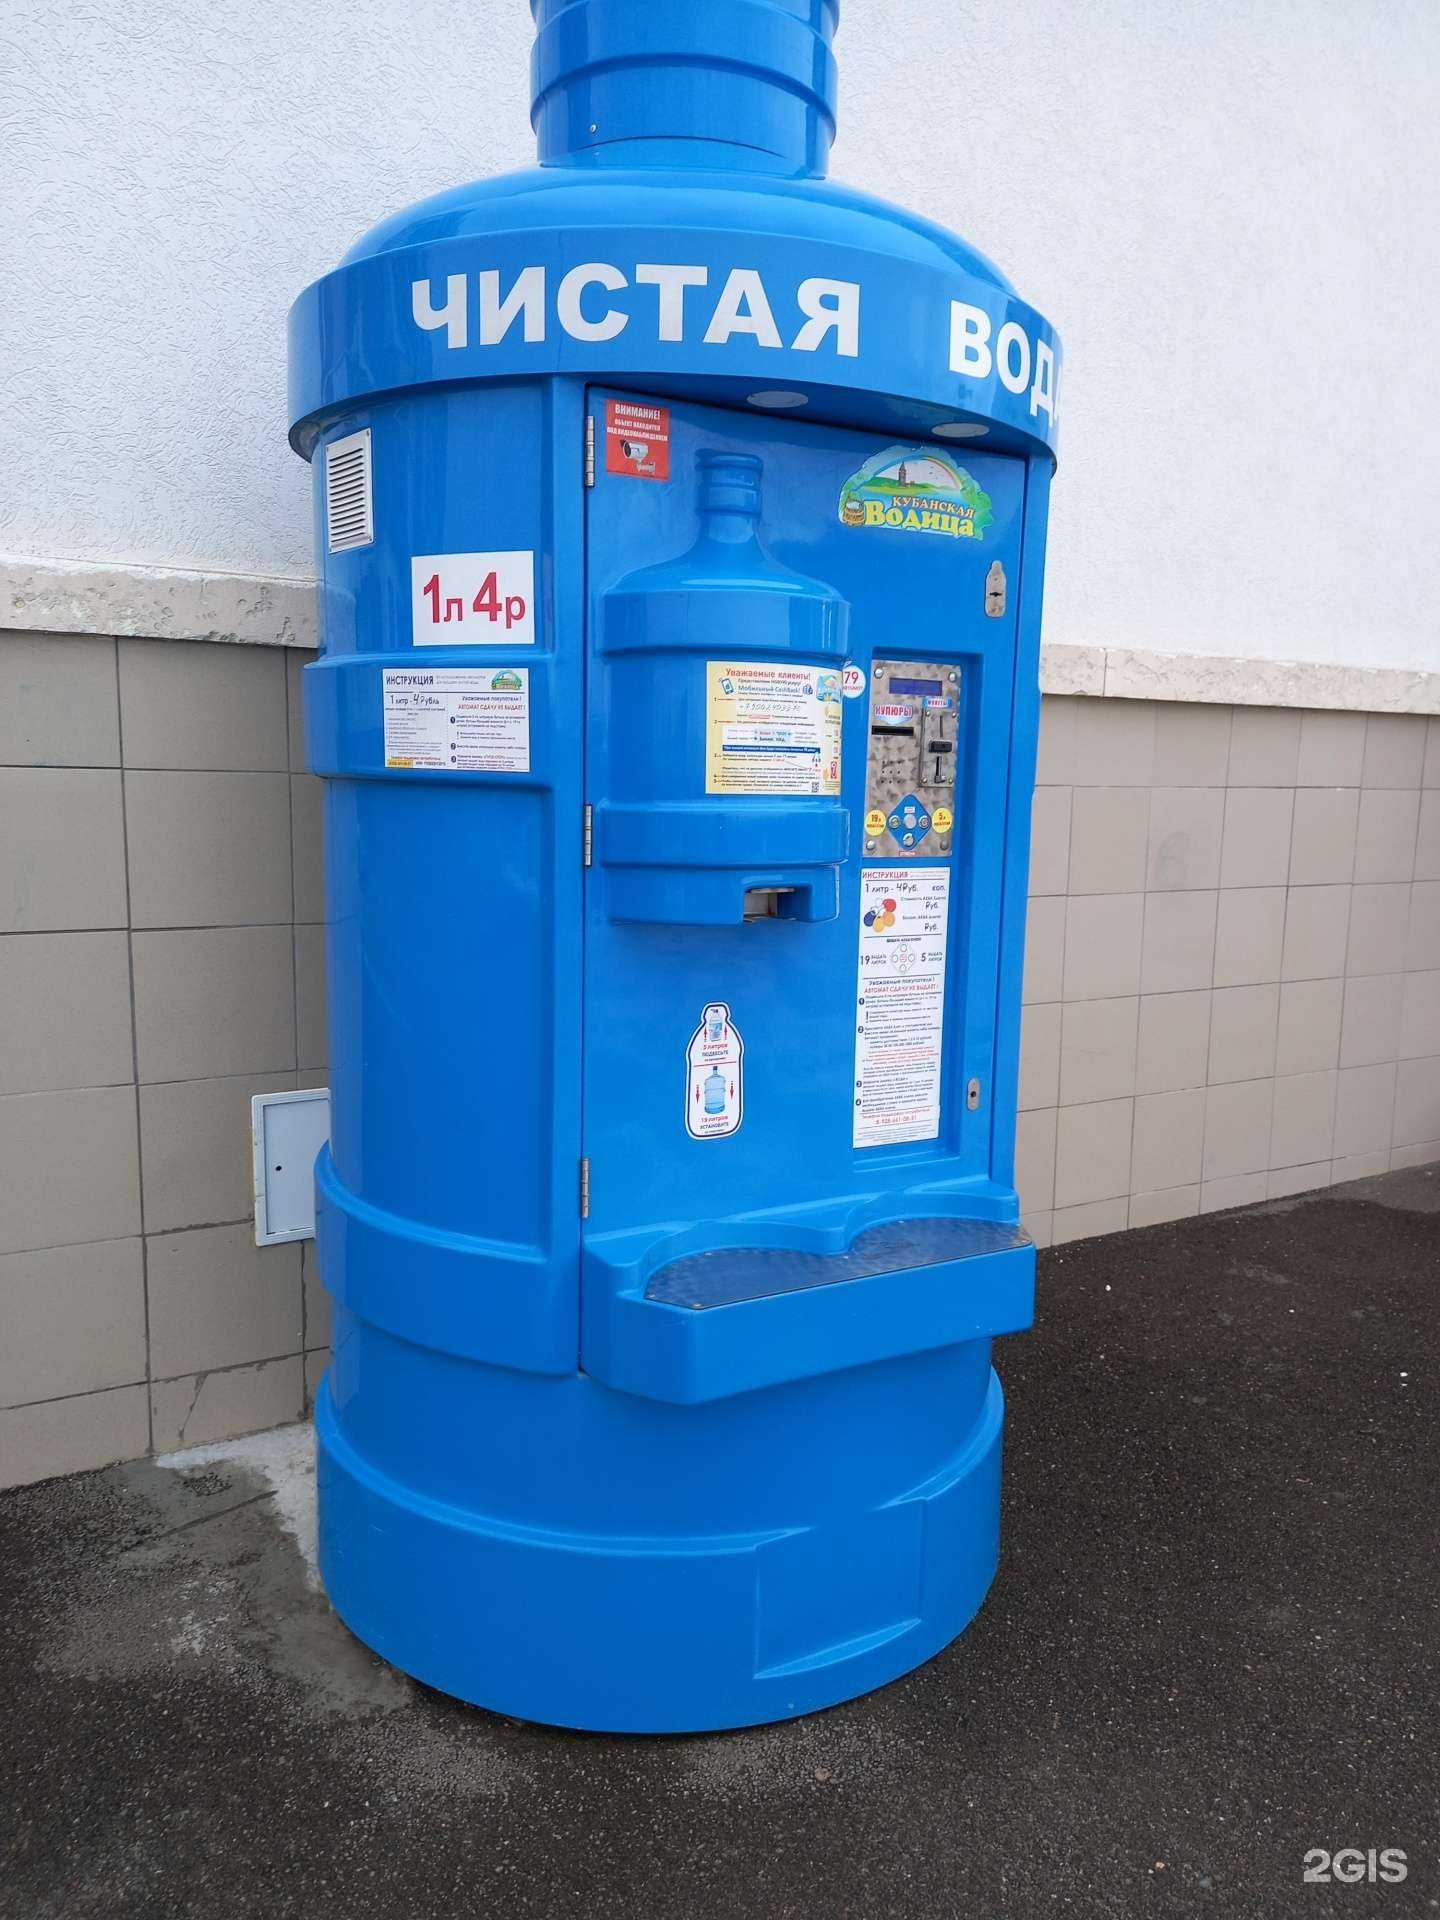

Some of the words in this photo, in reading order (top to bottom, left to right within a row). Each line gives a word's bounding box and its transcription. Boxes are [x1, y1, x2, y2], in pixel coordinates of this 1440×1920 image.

[411, 262, 861, 358] ЧИСТАЯ
[615, 404, 660, 420] ВНИМАНИЕ!
[614, 419, 633, 427] ОБЪЕКТ
[892, 496, 975, 519] КУБАНСКАЯ
[863, 501, 975, 537] Водица
[726, 668, 776, 679] Уважаемые
[778, 671, 811, 681] клиенты!
[844, 671, 859, 684] 79
[386, 675, 434, 687] ИНСТРУКЦИЯ
[875, 705, 913, 717] КУПЮРЫ
[863, 871, 908, 879] ИНСТРУКЦИЯ
[861, 955, 870, 965] 19
[921, 952, 926, 962] 5
